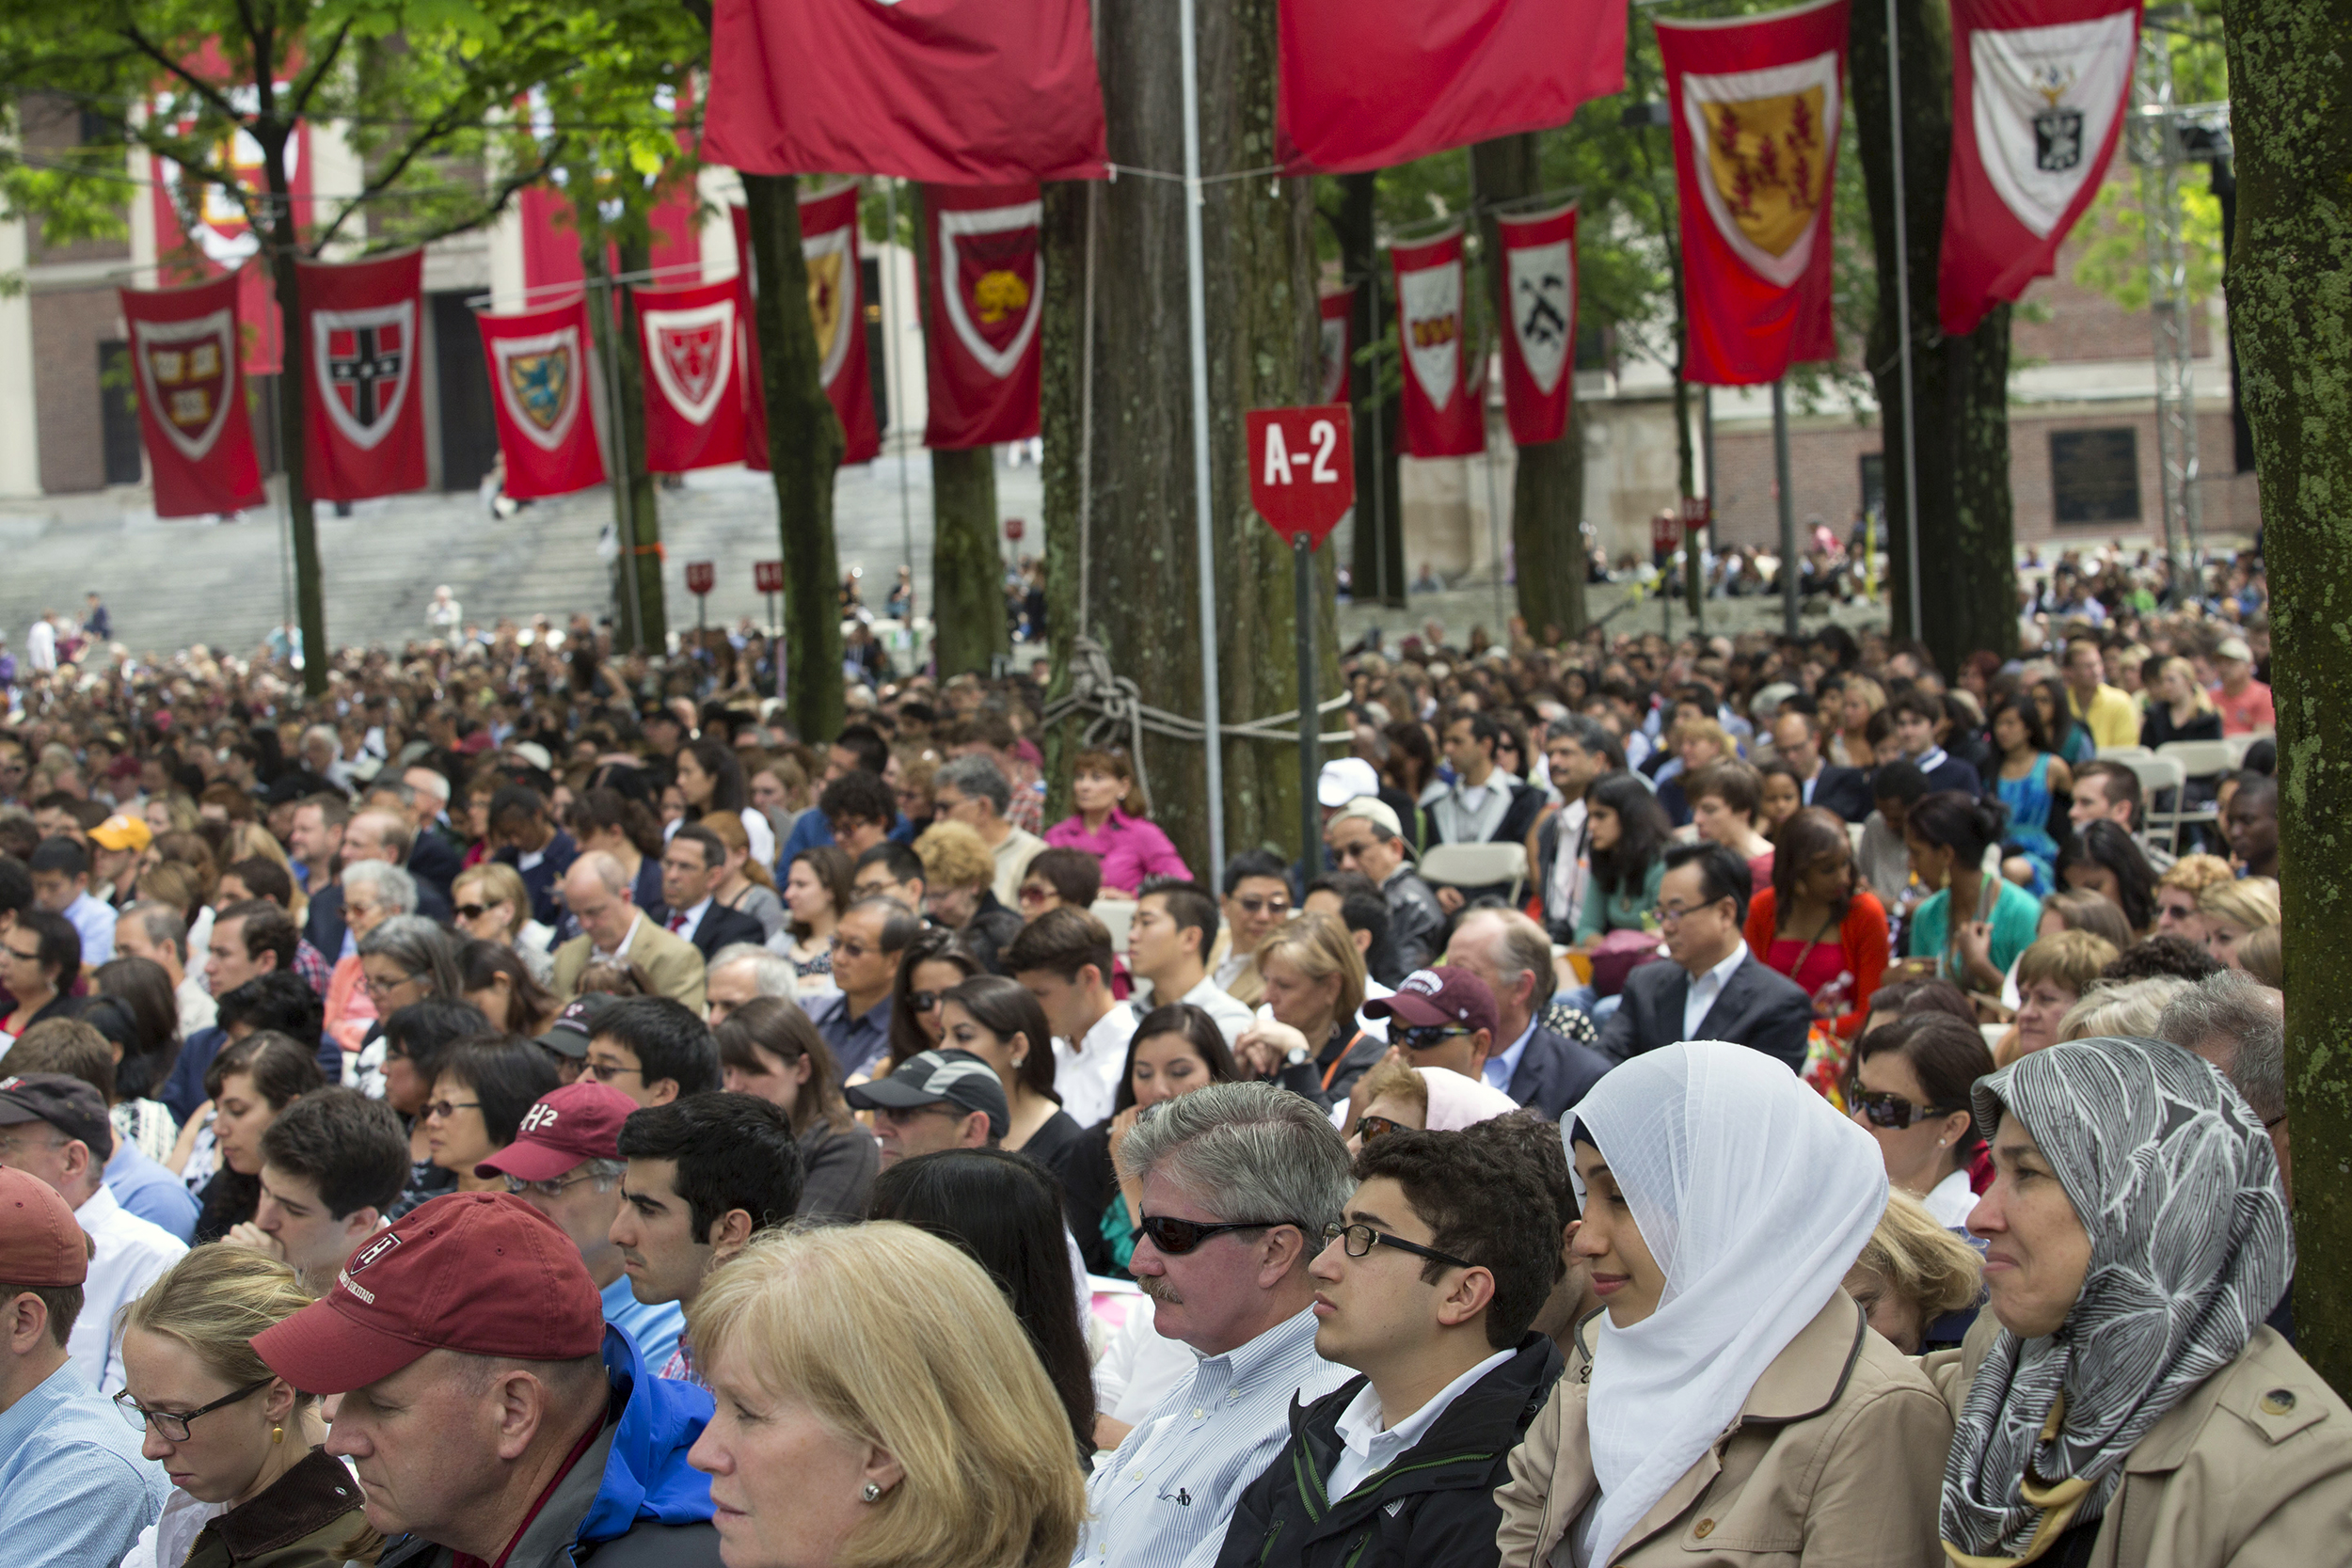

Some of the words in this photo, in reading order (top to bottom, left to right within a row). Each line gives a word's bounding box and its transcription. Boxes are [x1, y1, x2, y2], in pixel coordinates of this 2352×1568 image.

[1263, 420, 1339, 485] A-2
[360, 1237, 392, 1264] H
[347, 1280, 375, 1305] SKIING
